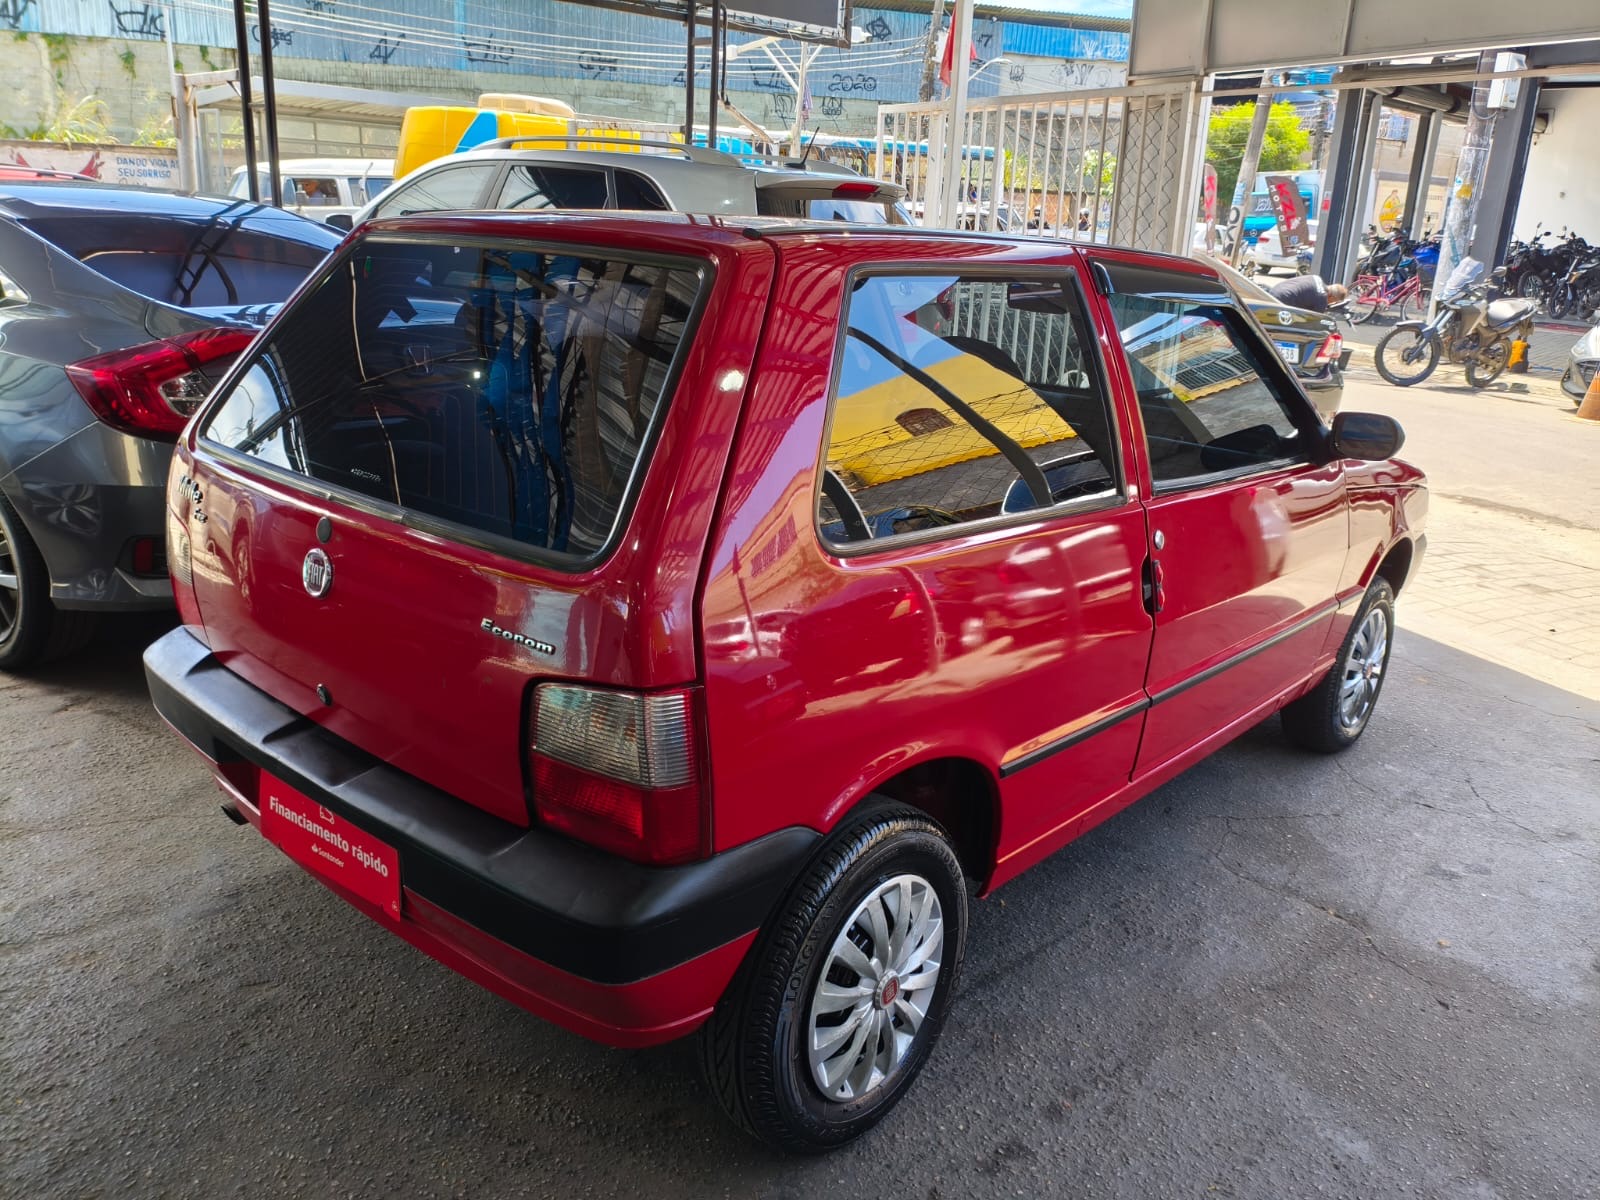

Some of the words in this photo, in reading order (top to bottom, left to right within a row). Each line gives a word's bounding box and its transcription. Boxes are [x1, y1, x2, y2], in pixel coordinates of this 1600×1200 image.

[828, 73, 877, 92] 2020
[116, 157, 148, 168] DANDO
[150, 158, 169, 169] VIDA
[118, 167, 136, 178] SEU
[137, 168, 172, 179] SORRISO
[307, 560, 325, 586] FIAT
[480, 617, 556, 655] Econom
[269, 795, 349, 853] Financiamento
[351, 844, 388, 877] rápido
[318, 847, 345, 868] Santander
